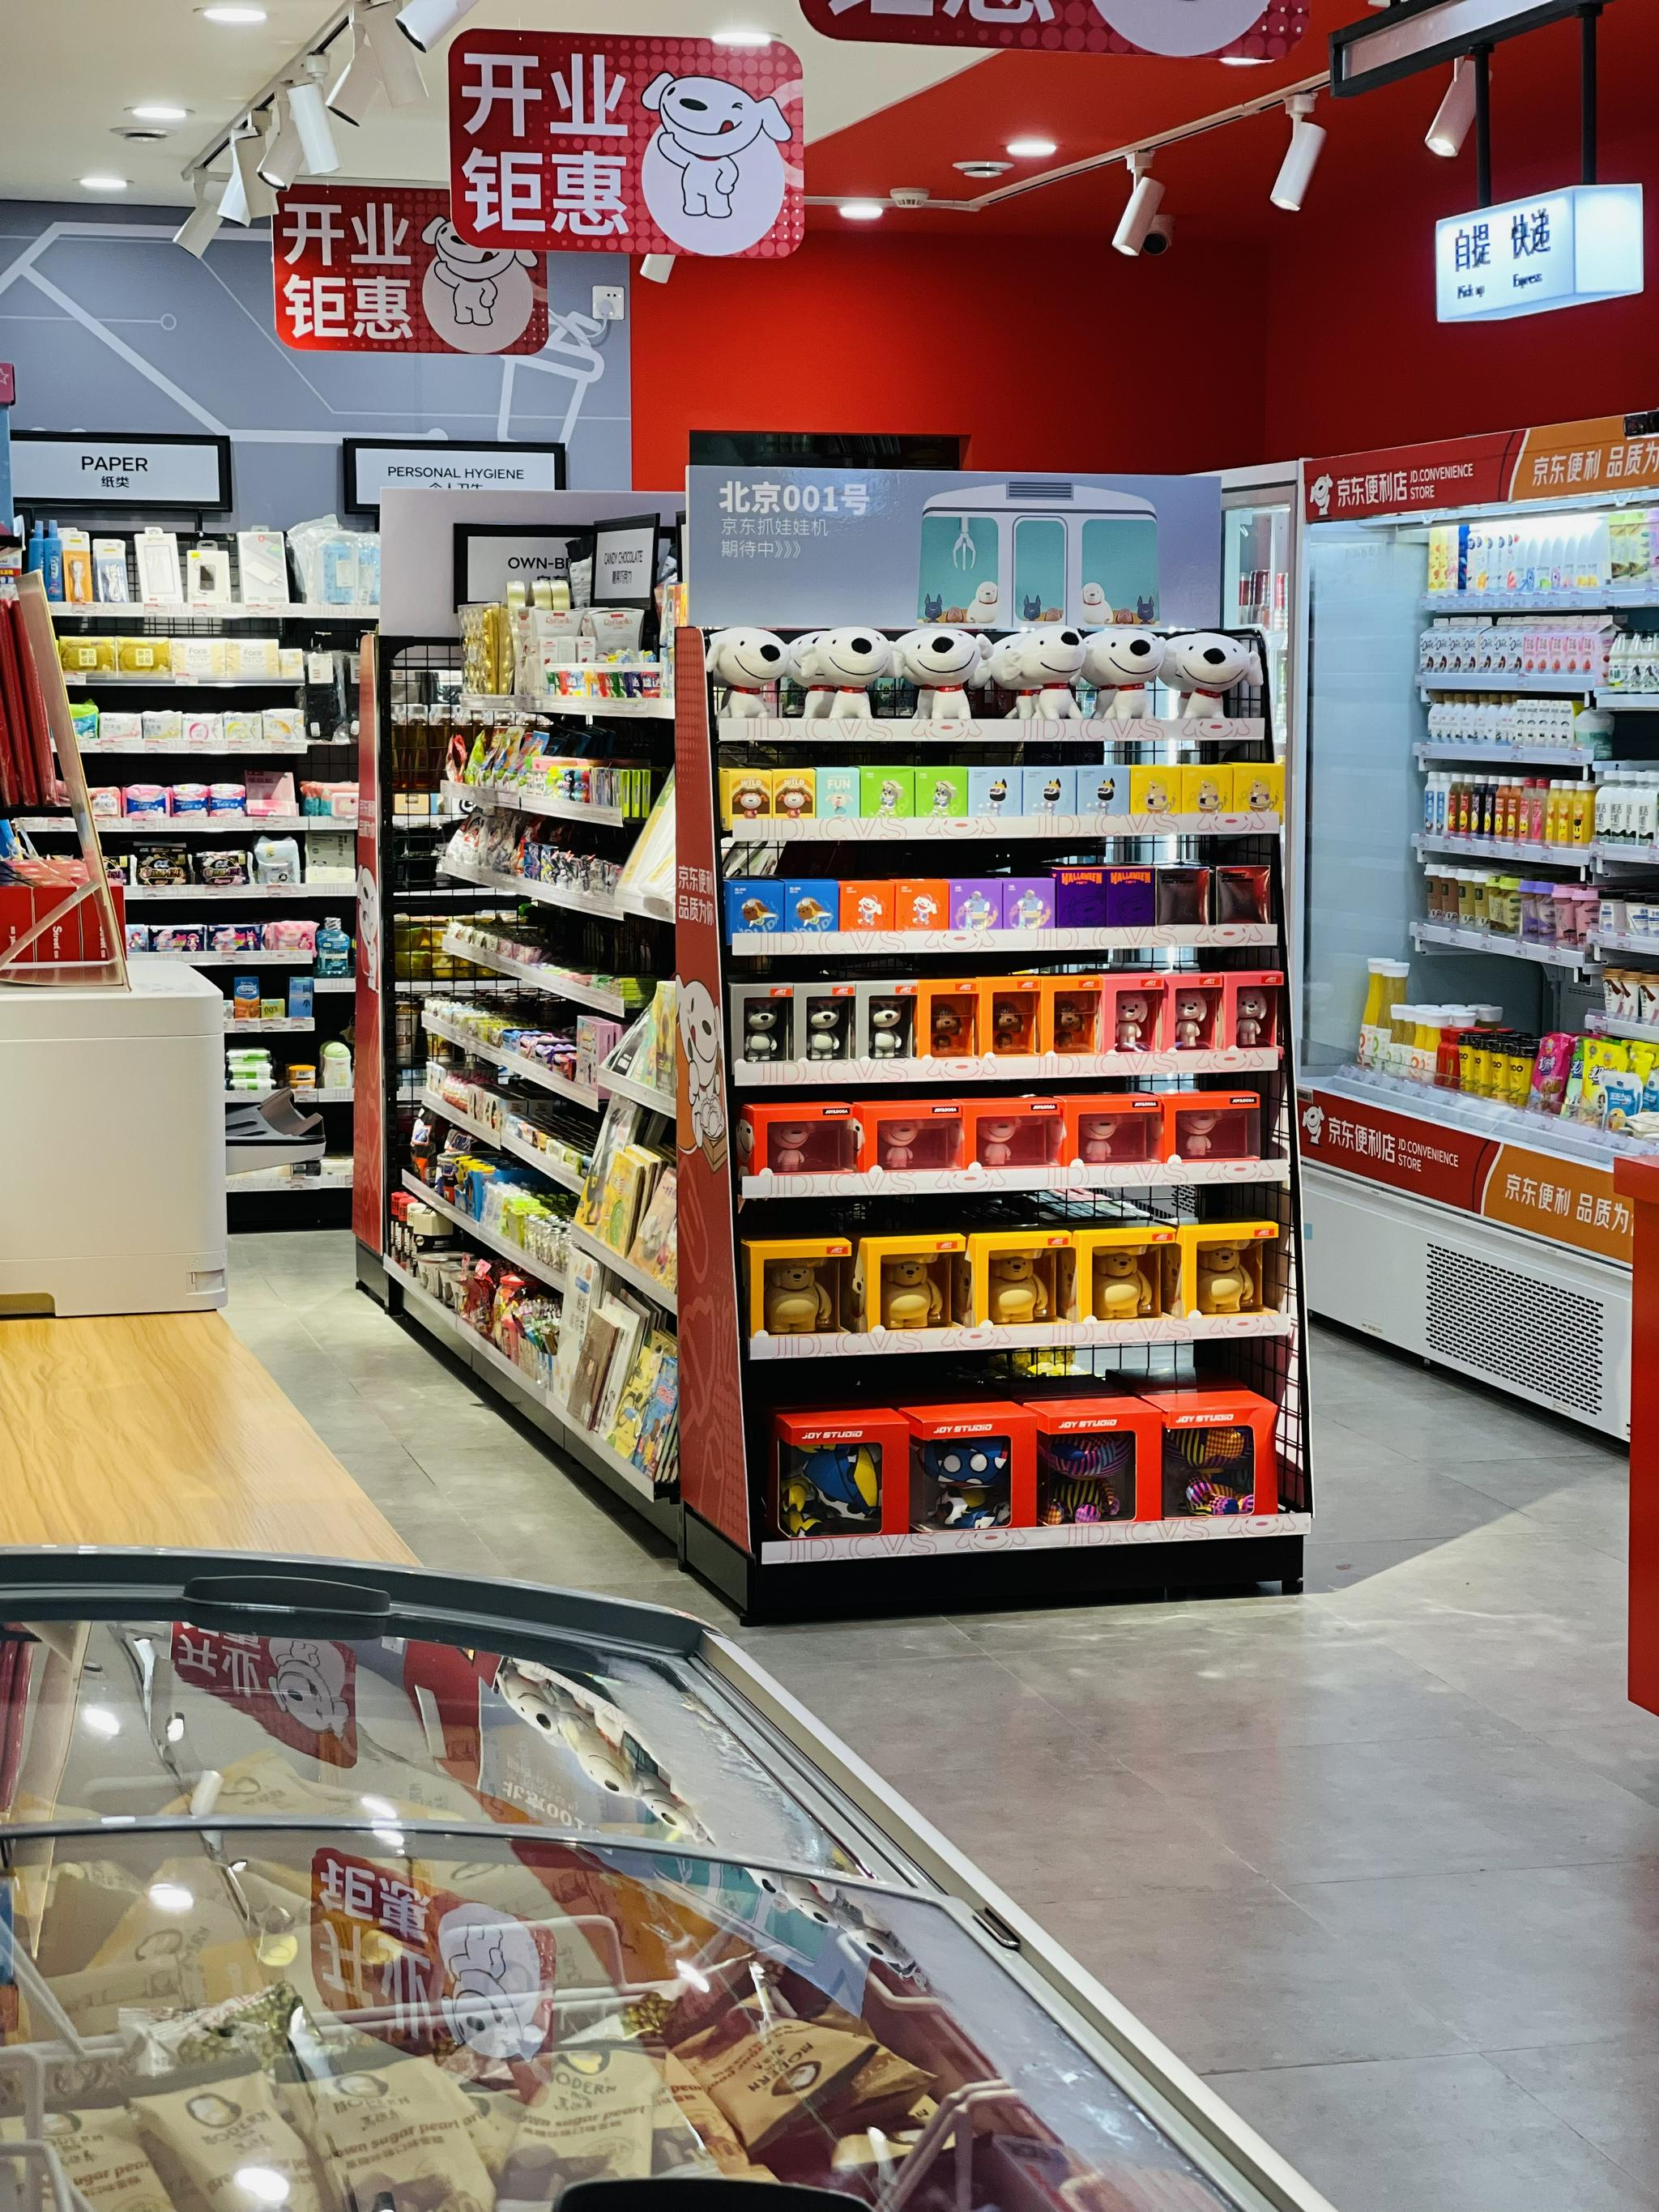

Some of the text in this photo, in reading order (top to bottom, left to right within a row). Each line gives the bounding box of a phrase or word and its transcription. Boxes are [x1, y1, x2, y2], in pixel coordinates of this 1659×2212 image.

[461, 52, 629, 139] 开业
[461, 147, 629, 236] 钜惠
[282, 202, 412, 266] 开业
[1455, 208, 1551, 272] 自提 快递
[283, 274, 414, 341] 钜惠
[81, 456, 148, 473] PAPER
[387, 466, 525, 479] PERSONAL HYGIENE
[1410, 462, 1474, 485] JD.CONVENIENCE
[1533, 439, 1659, 487] 京东便利 品质为
[100, 475, 130, 489] 纸类
[1337, 471, 1408, 508] 京东便利店
[1410, 484, 1435, 501] STORE
[719, 480, 871, 516] 北京001号
[721, 518, 830, 537] 京东抓娃娃机
[740, 778, 761, 788] WILD
[783, 778, 805, 787] WILD
[826, 778, 851, 791] FUN
[678, 865, 714, 896] 京东便利
[678, 894, 714, 927] 品质为你
[1328, 1117, 1396, 1164] 京东便利店
[1397, 1136, 1459, 1168] JD.CONVENIENCE
[1397, 1153, 1422, 1173] STORE
[1504, 1173, 1634, 1235] 京东便利 品质为
[933, 1424, 992, 1434] JOY STUDIO
[1058, 1419, 1117, 1429] JOY STUDIO
[1176, 1413, 1235, 1423] JOY STUDIO
[822, 1430, 864, 1439] STUDIO
